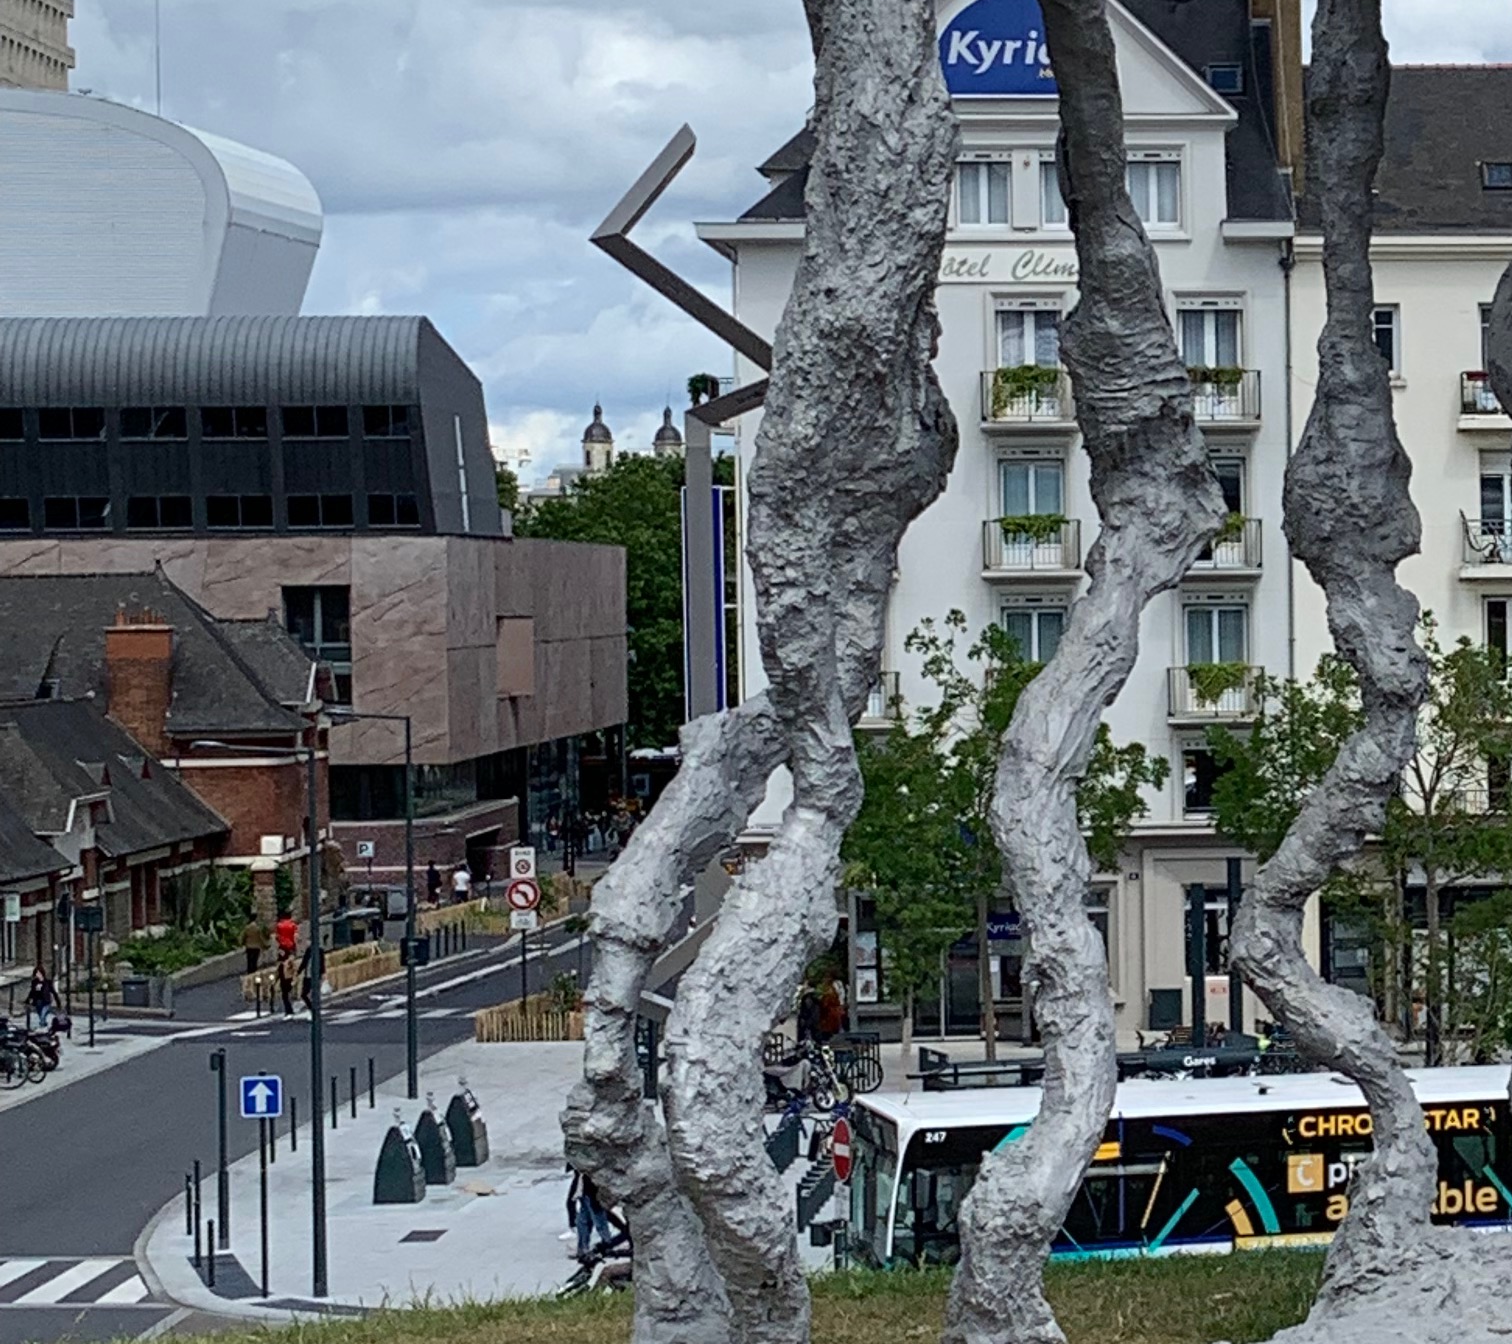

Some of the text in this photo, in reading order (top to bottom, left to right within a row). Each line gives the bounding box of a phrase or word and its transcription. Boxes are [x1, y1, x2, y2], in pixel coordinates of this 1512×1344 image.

[947, 30, 1051, 75] Kyri
[942, 254, 992, 278] ôtel
[925, 1131, 947, 1144] 247
